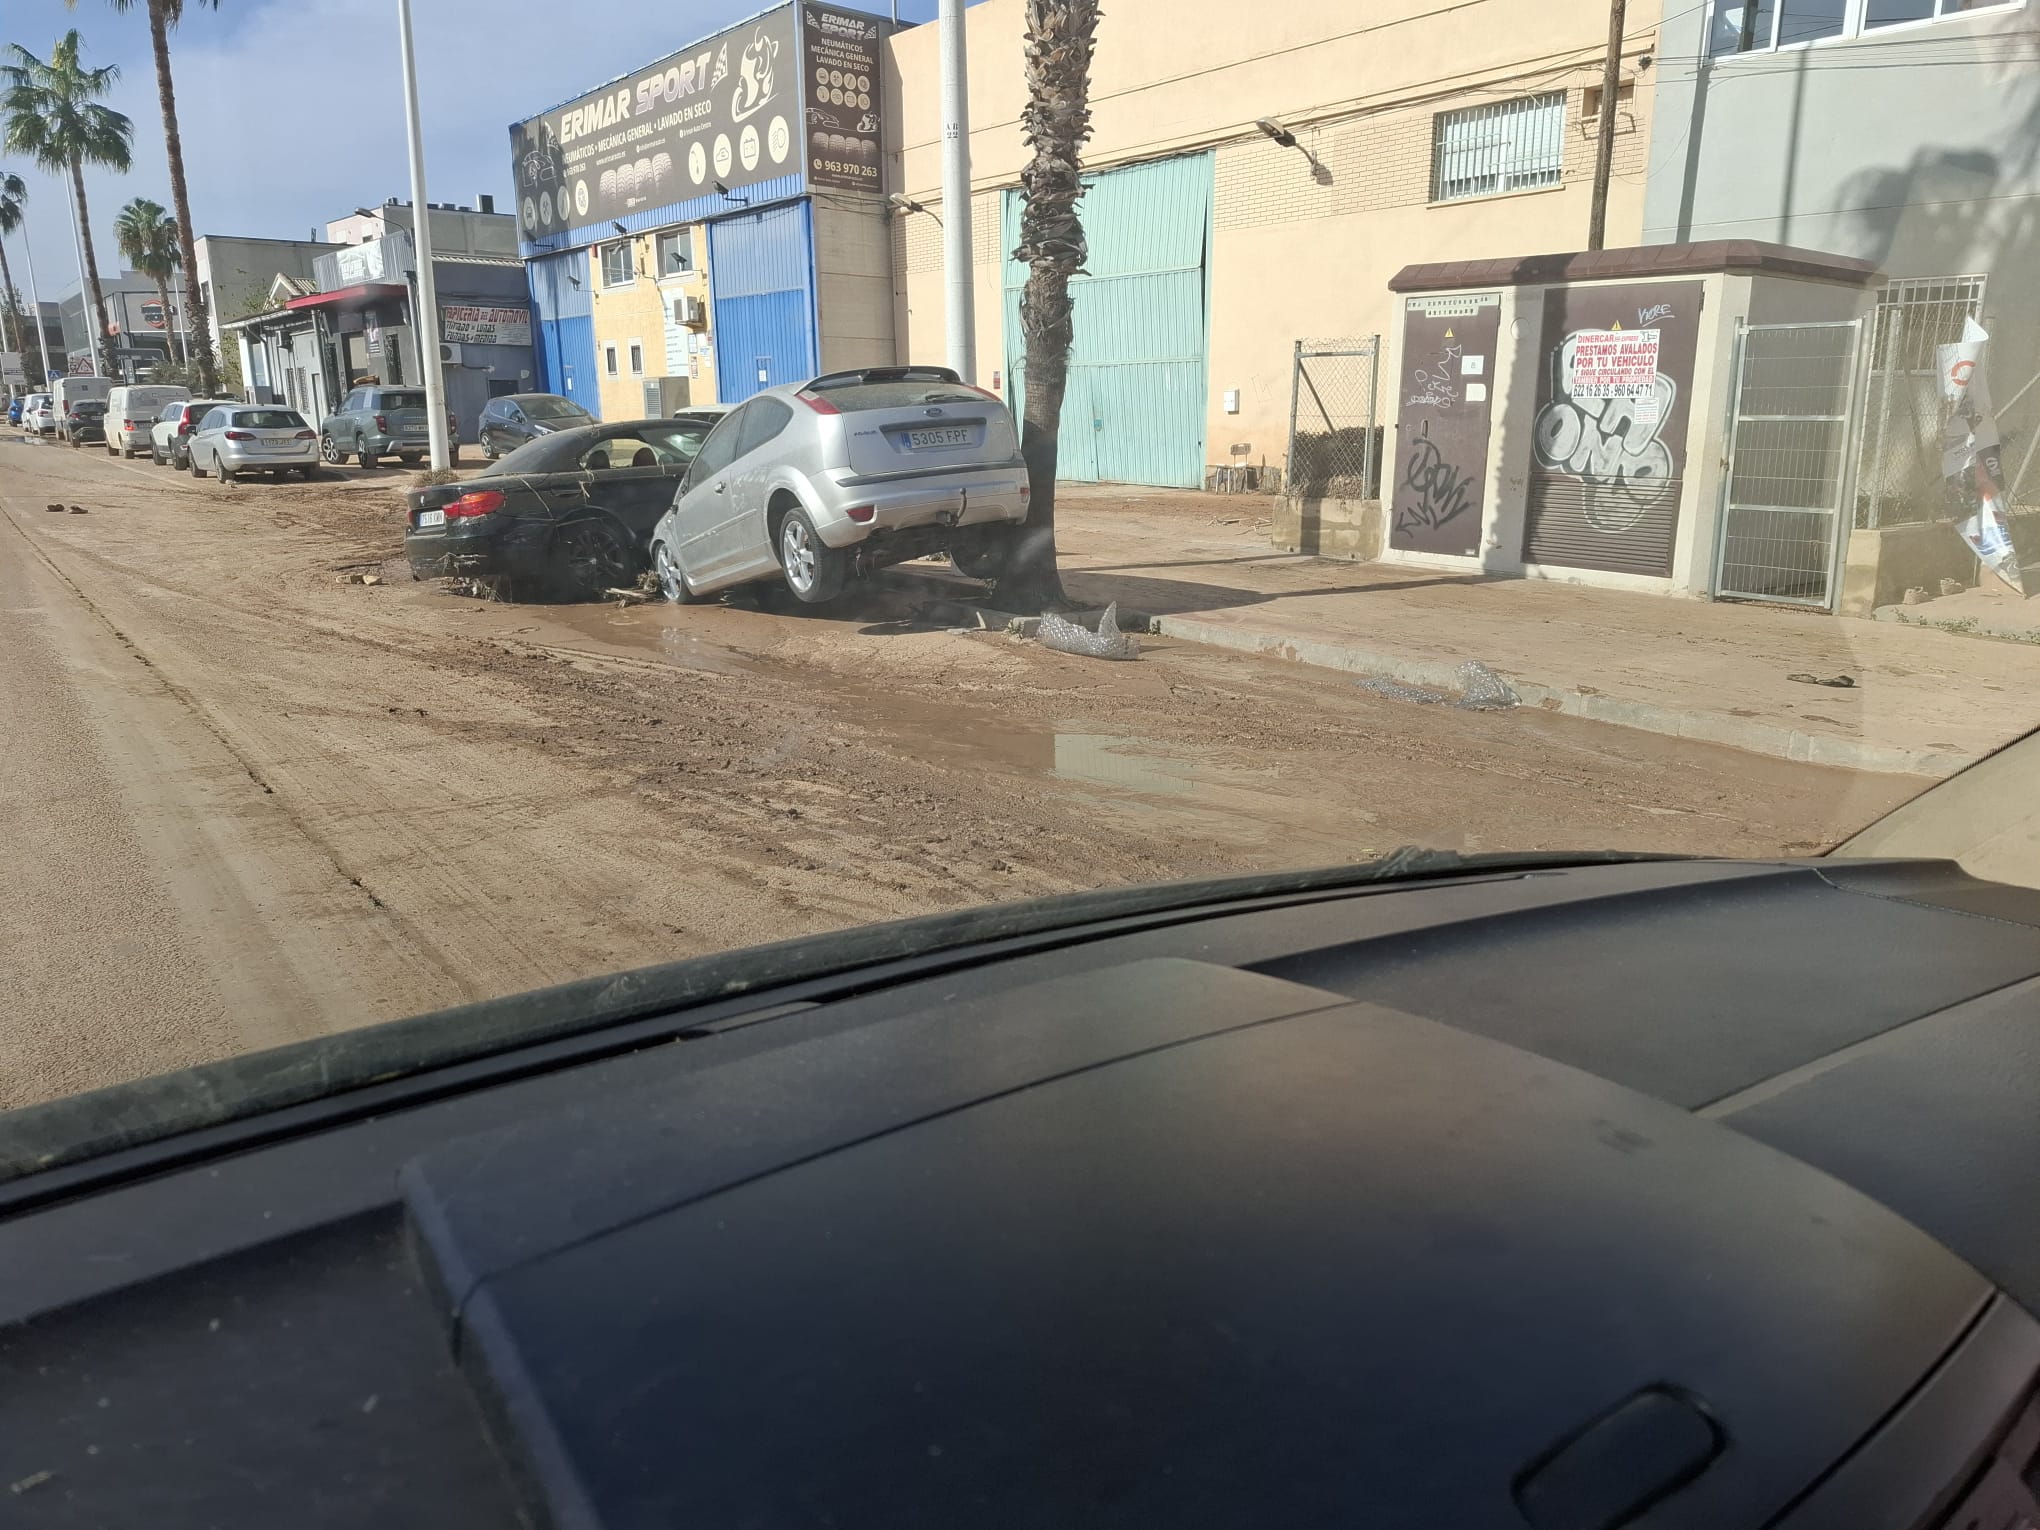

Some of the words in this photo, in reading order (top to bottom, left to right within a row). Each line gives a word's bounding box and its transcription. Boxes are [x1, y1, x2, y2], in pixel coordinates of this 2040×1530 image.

[821, 13, 865, 30] ERIMAR
[821, 23, 865, 41] SPORT
[821, 38, 863, 53] NEUMÁTICOS
[811, 45, 844, 59] MECÁNICA
[845, 53, 874, 64] GENERAL
[816, 55, 842, 67] LAVADO
[843, 62, 852, 70] EN
[853, 63, 869, 72] SECO
[560, 89, 631, 144] ERIMAR
[635, 52, 712, 115] SPORT
[599, 129, 627, 152] MECÁNICA
[627, 121, 653, 141] GENERAL
[657, 109, 683, 131] LAVADO
[684, 106, 694, 121] EN
[694, 99, 712, 117] SECO
[825, 160, 841, 171] 963
[843, 163, 859, 174] 970
[861, 165, 877, 176] 263
[1577, 335, 1614, 343] DINERCAR
[1576, 345, 1617, 357] PRESTAMOS
[1620, 343, 1657, 355] AVALADOS
[1576, 358, 1593, 368] POR
[1597, 357, 1608, 368] TU
[1611, 355, 1654, 367] VEHICULO
[1598, 368, 1632, 376] CIRCULANDO
[1648, 367, 1654, 375] EL
[1573, 385, 1585, 397] 622
[1586, 385, 1593, 397] 16
[1602, 385, 1610, 396] 35
[1614, 384, 1626, 396] 960
[1627, 384, 1635, 396] 64
[1635, 384, 1644, 396] 47
[1645, 384, 1653, 396] 71
[911, 431, 944, 446] 5305
[947, 429, 968, 442] FPF
